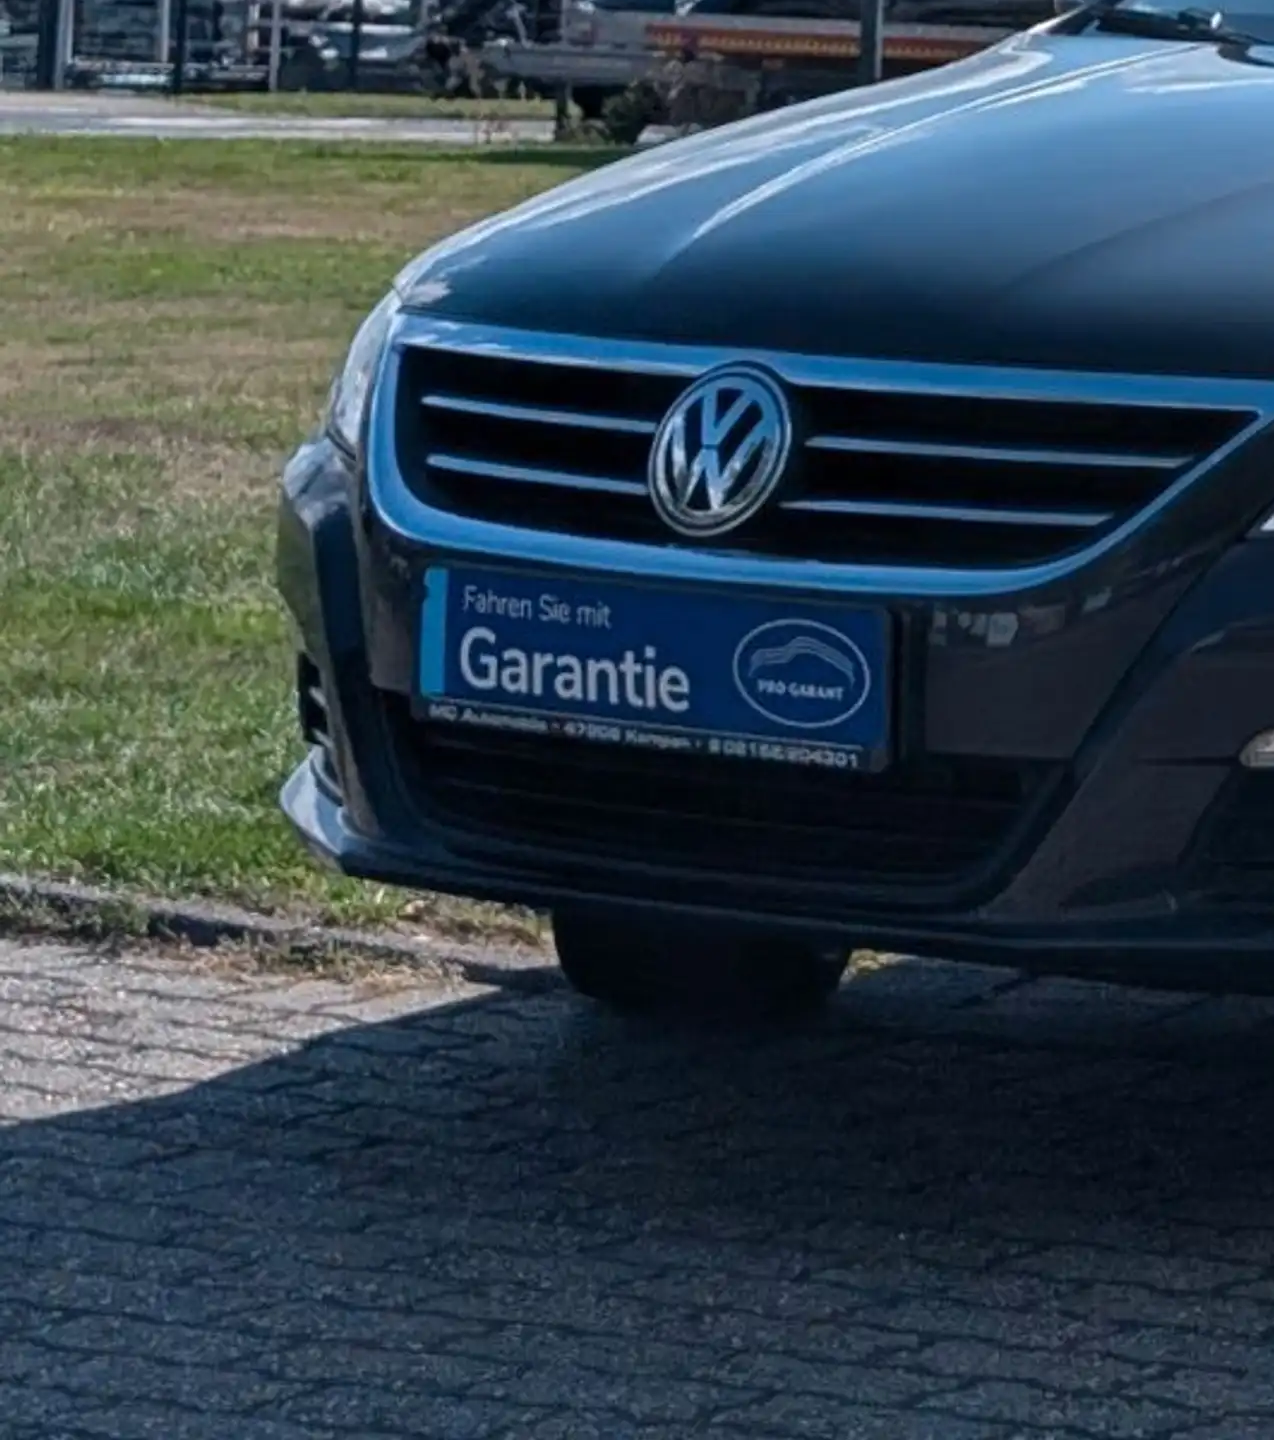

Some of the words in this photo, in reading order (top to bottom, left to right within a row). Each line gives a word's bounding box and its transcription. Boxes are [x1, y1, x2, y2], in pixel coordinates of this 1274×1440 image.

[462, 585, 532, 619] Fahren
[538, 594, 571, 624] Sie
[576, 601, 612, 629] mit
[460, 626, 690, 713] Garantie
